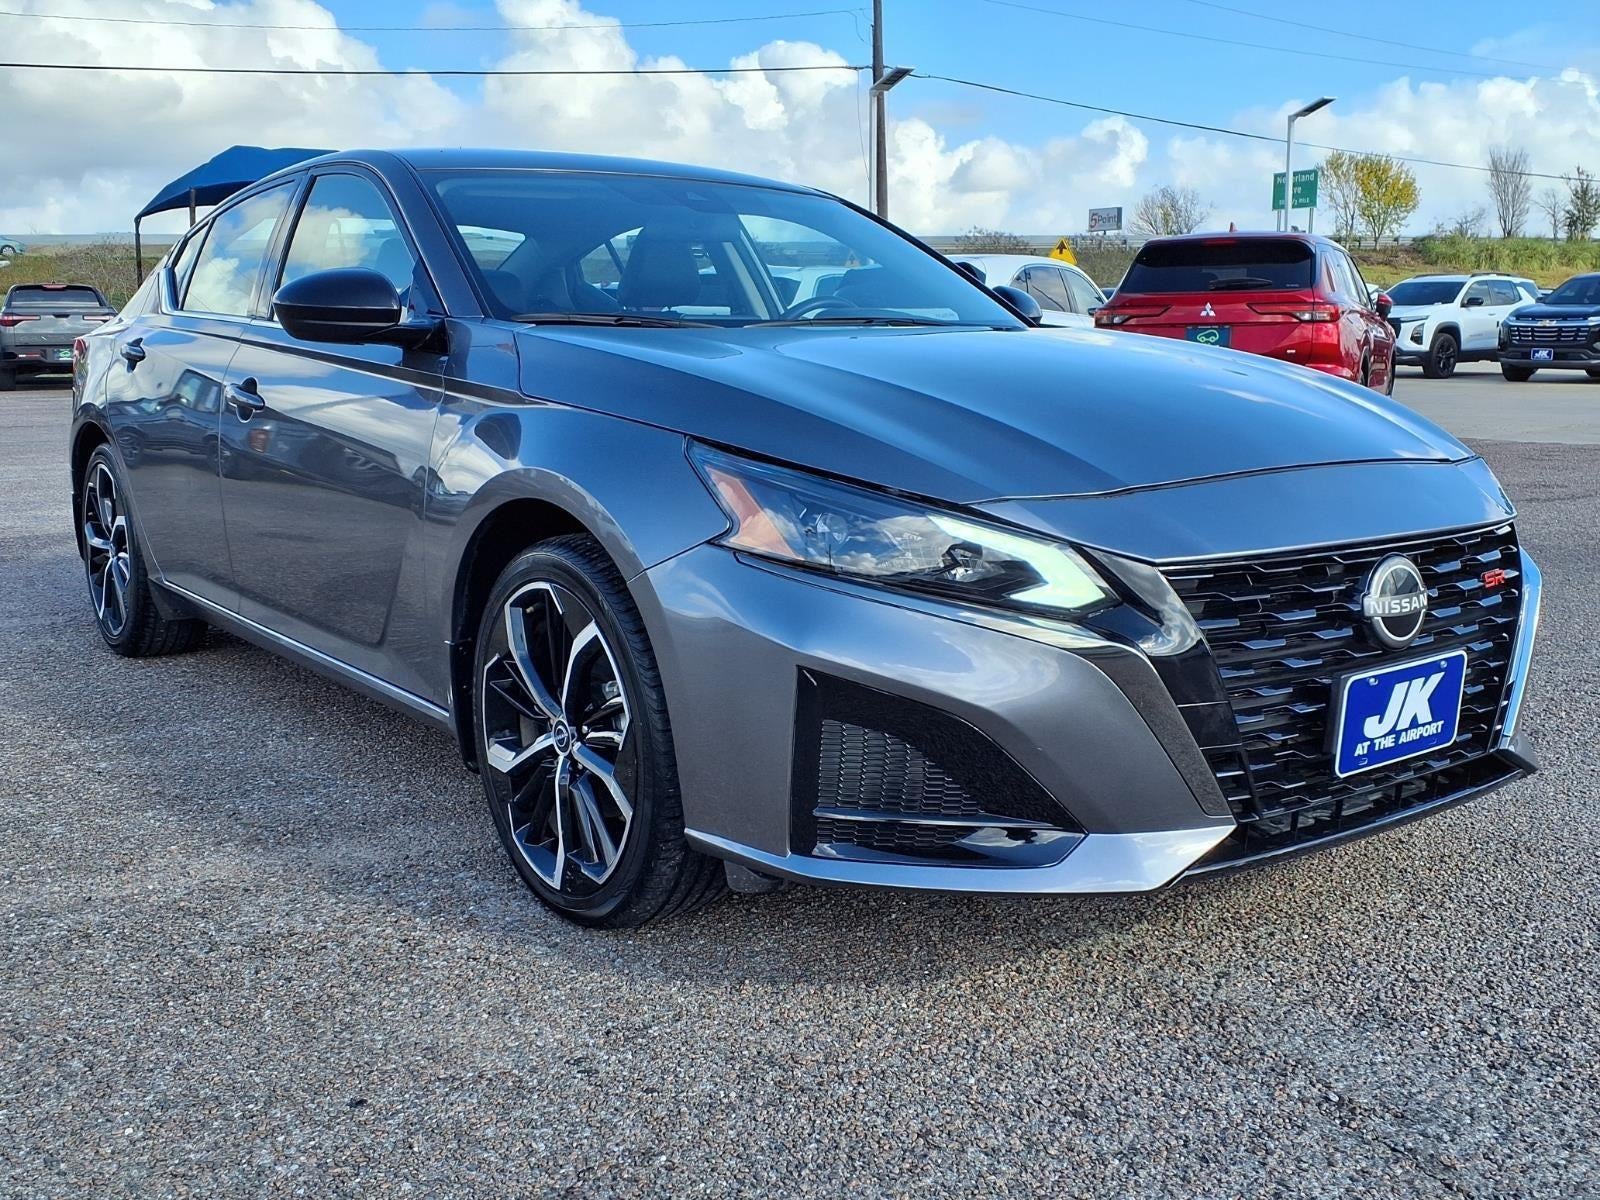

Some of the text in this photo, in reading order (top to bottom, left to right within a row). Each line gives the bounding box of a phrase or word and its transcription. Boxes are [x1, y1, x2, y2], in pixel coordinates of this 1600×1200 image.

[1534, 350, 1550, 359] JK
[1482, 568, 1505, 588] SR
[1369, 593, 1428, 615] NISSAN
[1363, 671, 1446, 738] JK
[1354, 720, 1445, 757] AT THE AIRPORT
